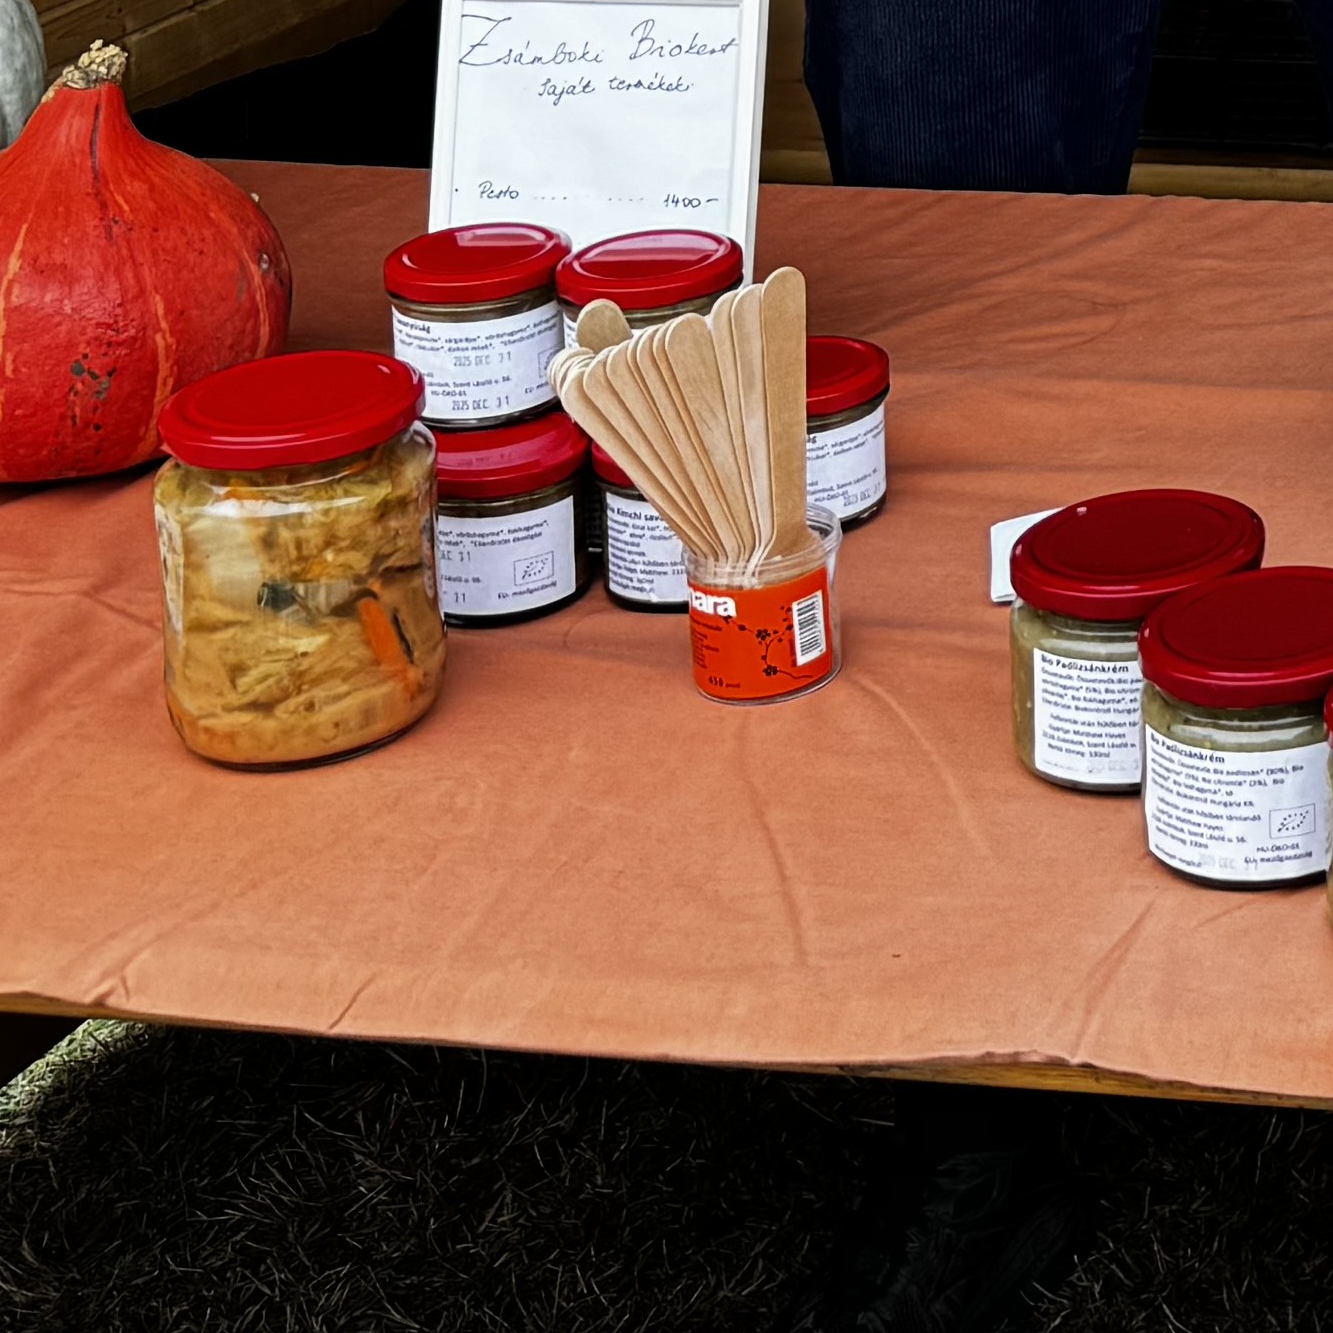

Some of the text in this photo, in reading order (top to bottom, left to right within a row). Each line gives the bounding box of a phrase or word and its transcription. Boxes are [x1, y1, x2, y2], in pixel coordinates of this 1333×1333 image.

[459, 14, 738, 66] Zsámboki Biokert
[478, 180, 519, 200] Pesto
[617, 507, 642, 519] Kimchi
[1041, 654, 1129, 674] Bio Padlizsánkrém
